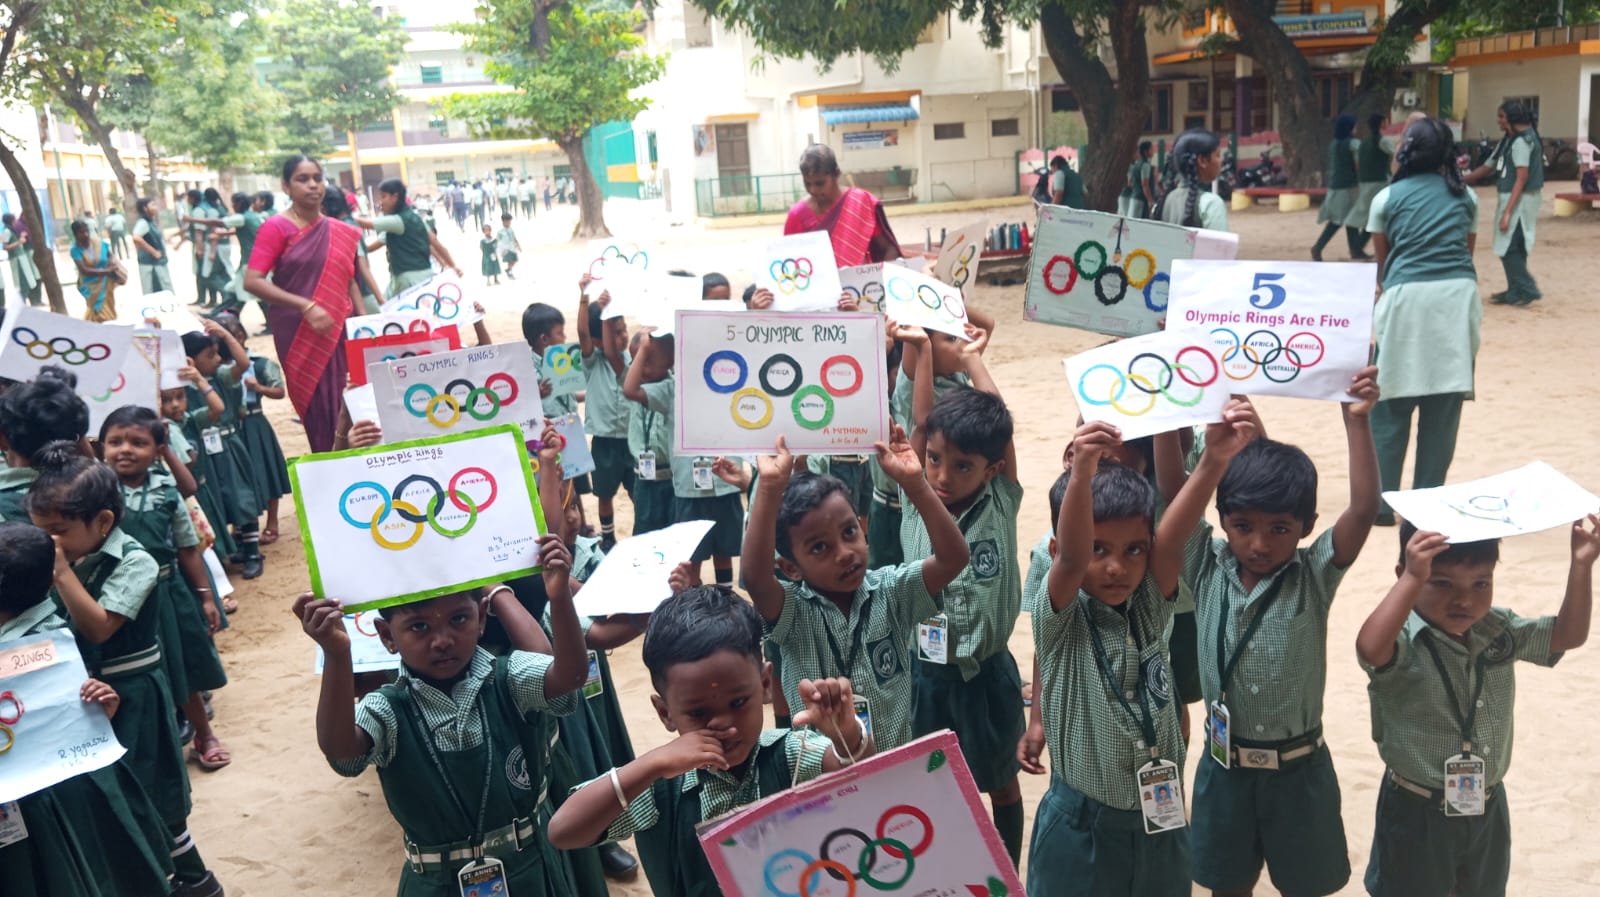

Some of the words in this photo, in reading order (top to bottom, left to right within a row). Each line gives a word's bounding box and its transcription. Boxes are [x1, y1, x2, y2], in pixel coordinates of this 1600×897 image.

[1249, 272, 1287, 310] 5
[1185, 310, 1241, 326] Olympic
[1245, 311, 1285, 327] Rings
[1289, 313, 1315, 326] Are
[1320, 314, 1350, 328] Five
[812, 325, 847, 344] RING
[396, 365, 408, 379] 5
[418, 358, 458, 373] OLYMPIC
[467, 350, 495, 364] RINGS
[1267, 365, 1296, 373] AUSTRALIA
